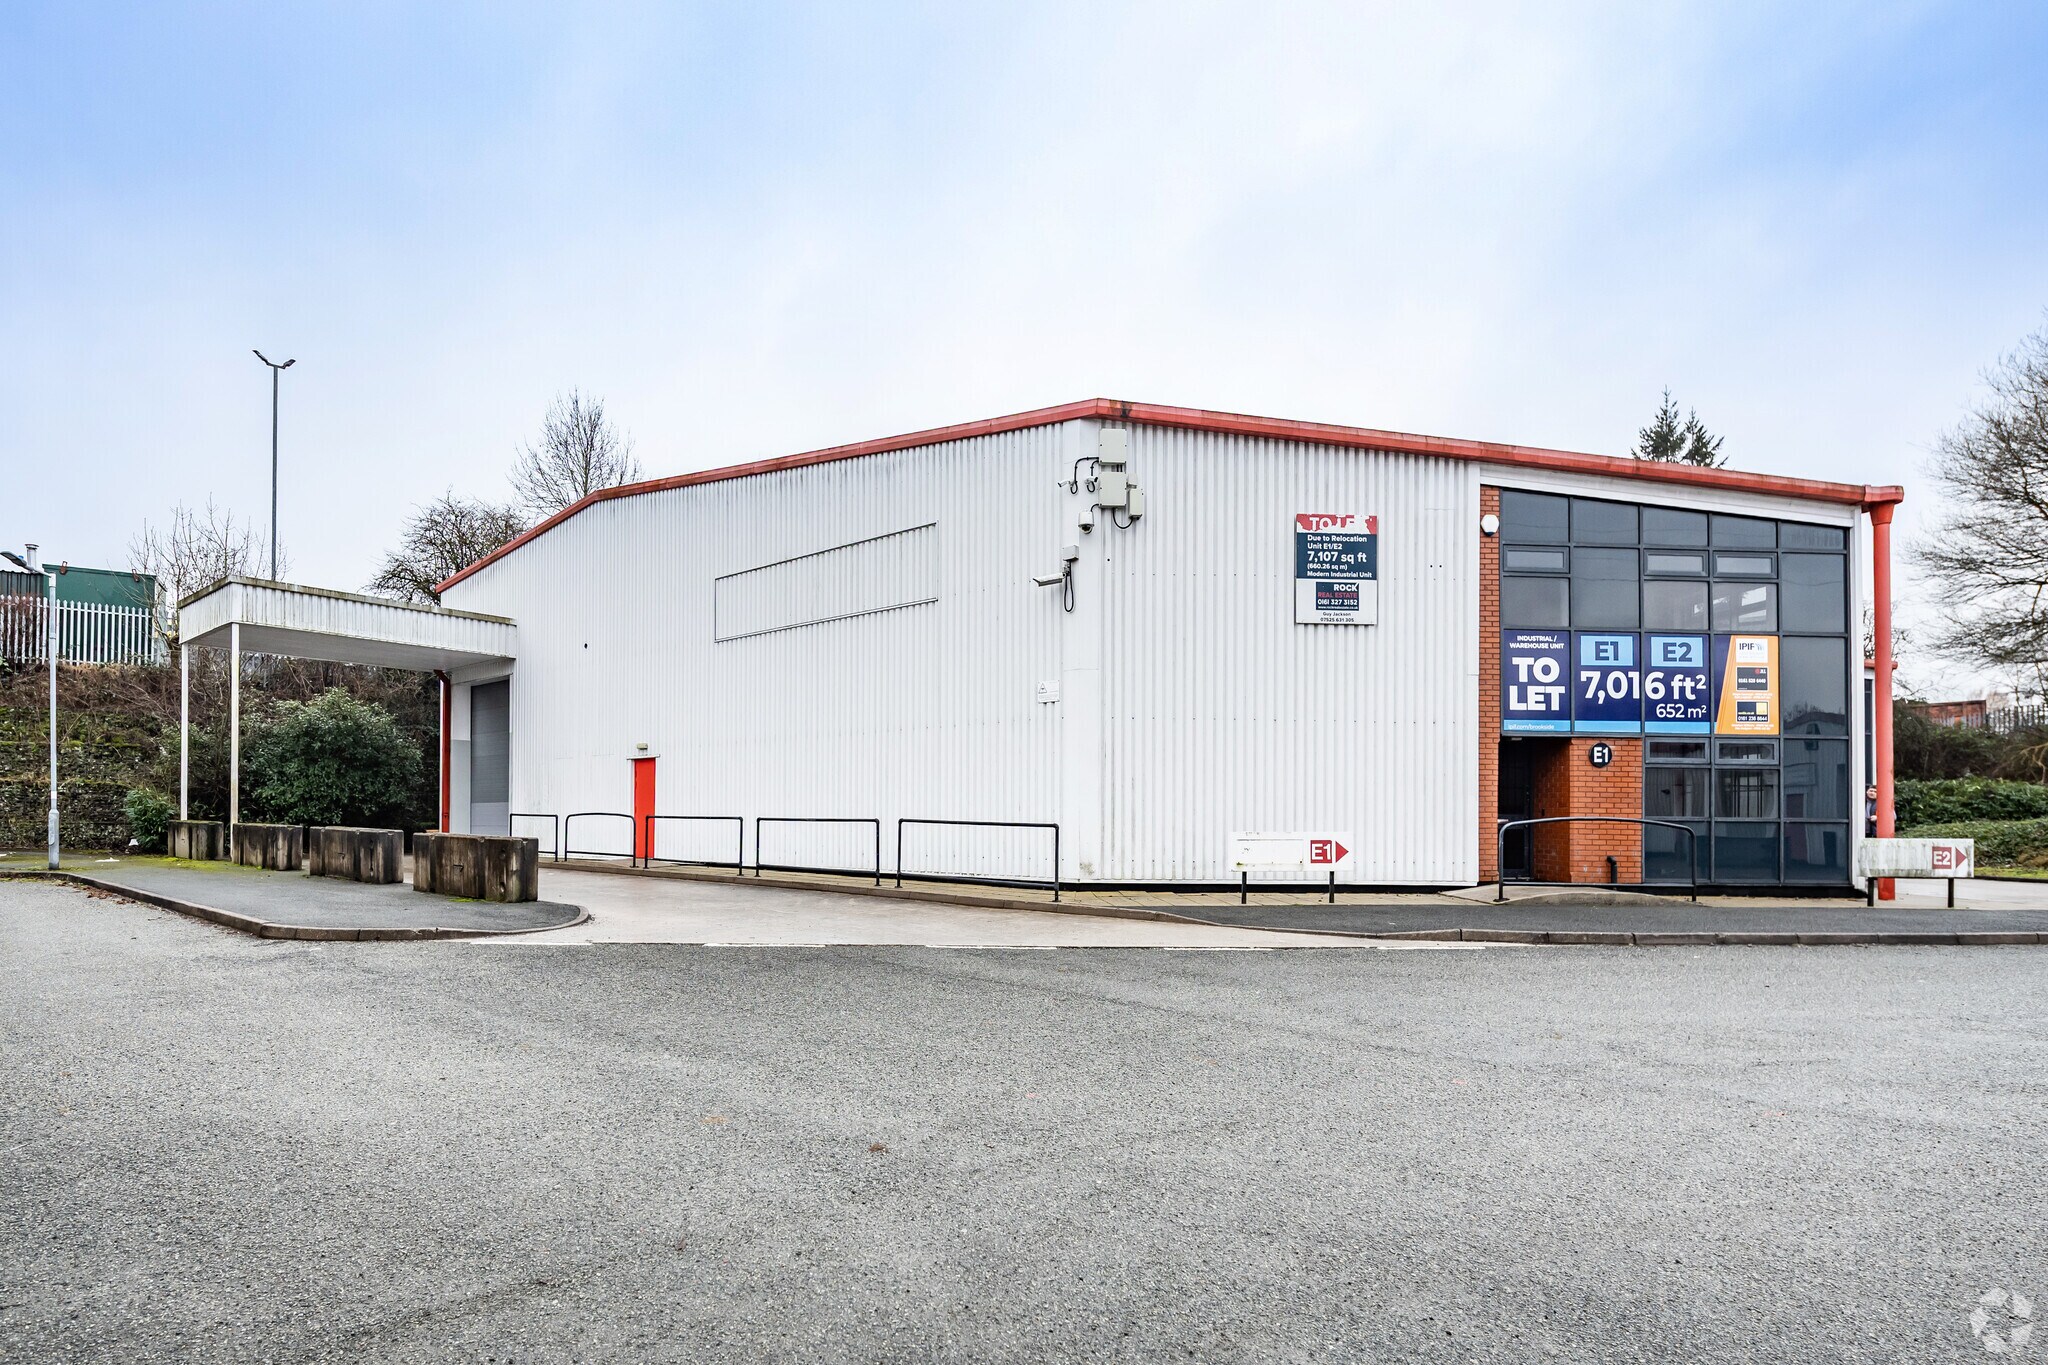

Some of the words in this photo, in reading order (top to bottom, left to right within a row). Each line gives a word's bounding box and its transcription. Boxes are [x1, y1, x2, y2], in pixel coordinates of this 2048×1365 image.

[1309, 517, 1332, 531] TO
[1307, 551, 1338, 562] 7,107
[1341, 554, 1354, 564] sq
[1357, 552, 1367, 562] ft
[1333, 582, 1359, 591] ROCK
[1594, 641, 1619, 661] E1
[1662, 642, 1693, 662] E2
[1512, 657, 1560, 683] TO
[1580, 670, 1666, 704] 7,016
[1509, 685, 1565, 711] LET
[1656, 703, 1685, 718] 652
[1594, 746, 1608, 763] E1
[1311, 843, 1331, 860] E1
[1933, 851, 1951, 865] E2
